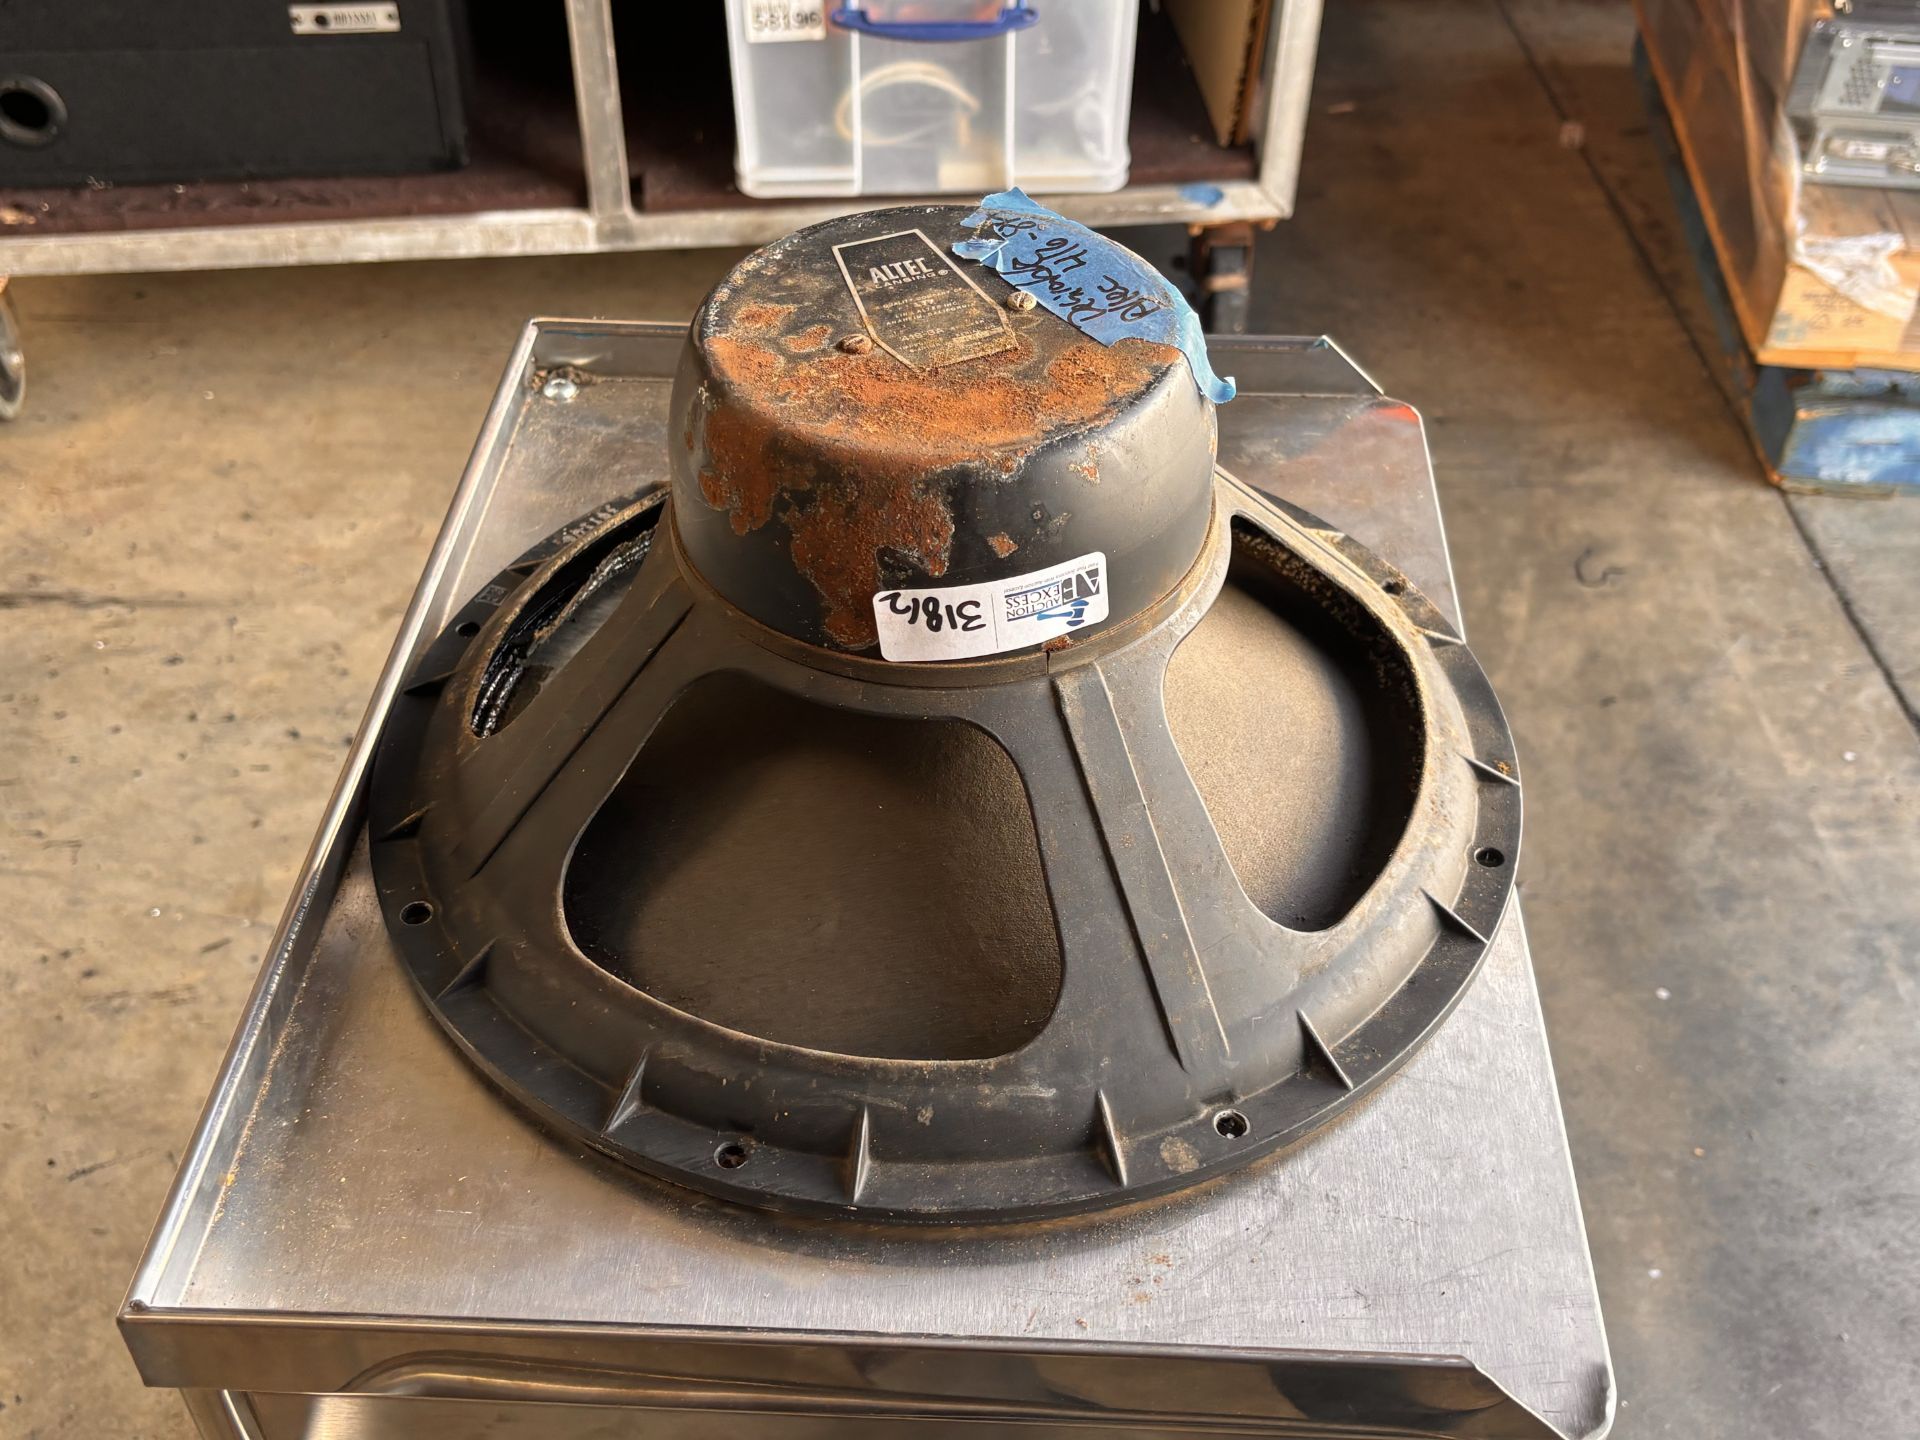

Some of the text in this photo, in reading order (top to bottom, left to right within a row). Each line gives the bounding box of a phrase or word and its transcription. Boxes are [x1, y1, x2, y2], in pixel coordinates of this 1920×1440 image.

[869, 257, 933, 284] ALTEC
[1005, 584, 1060, 609] EXCESS
[1006, 596, 1060, 618] AUCTION
